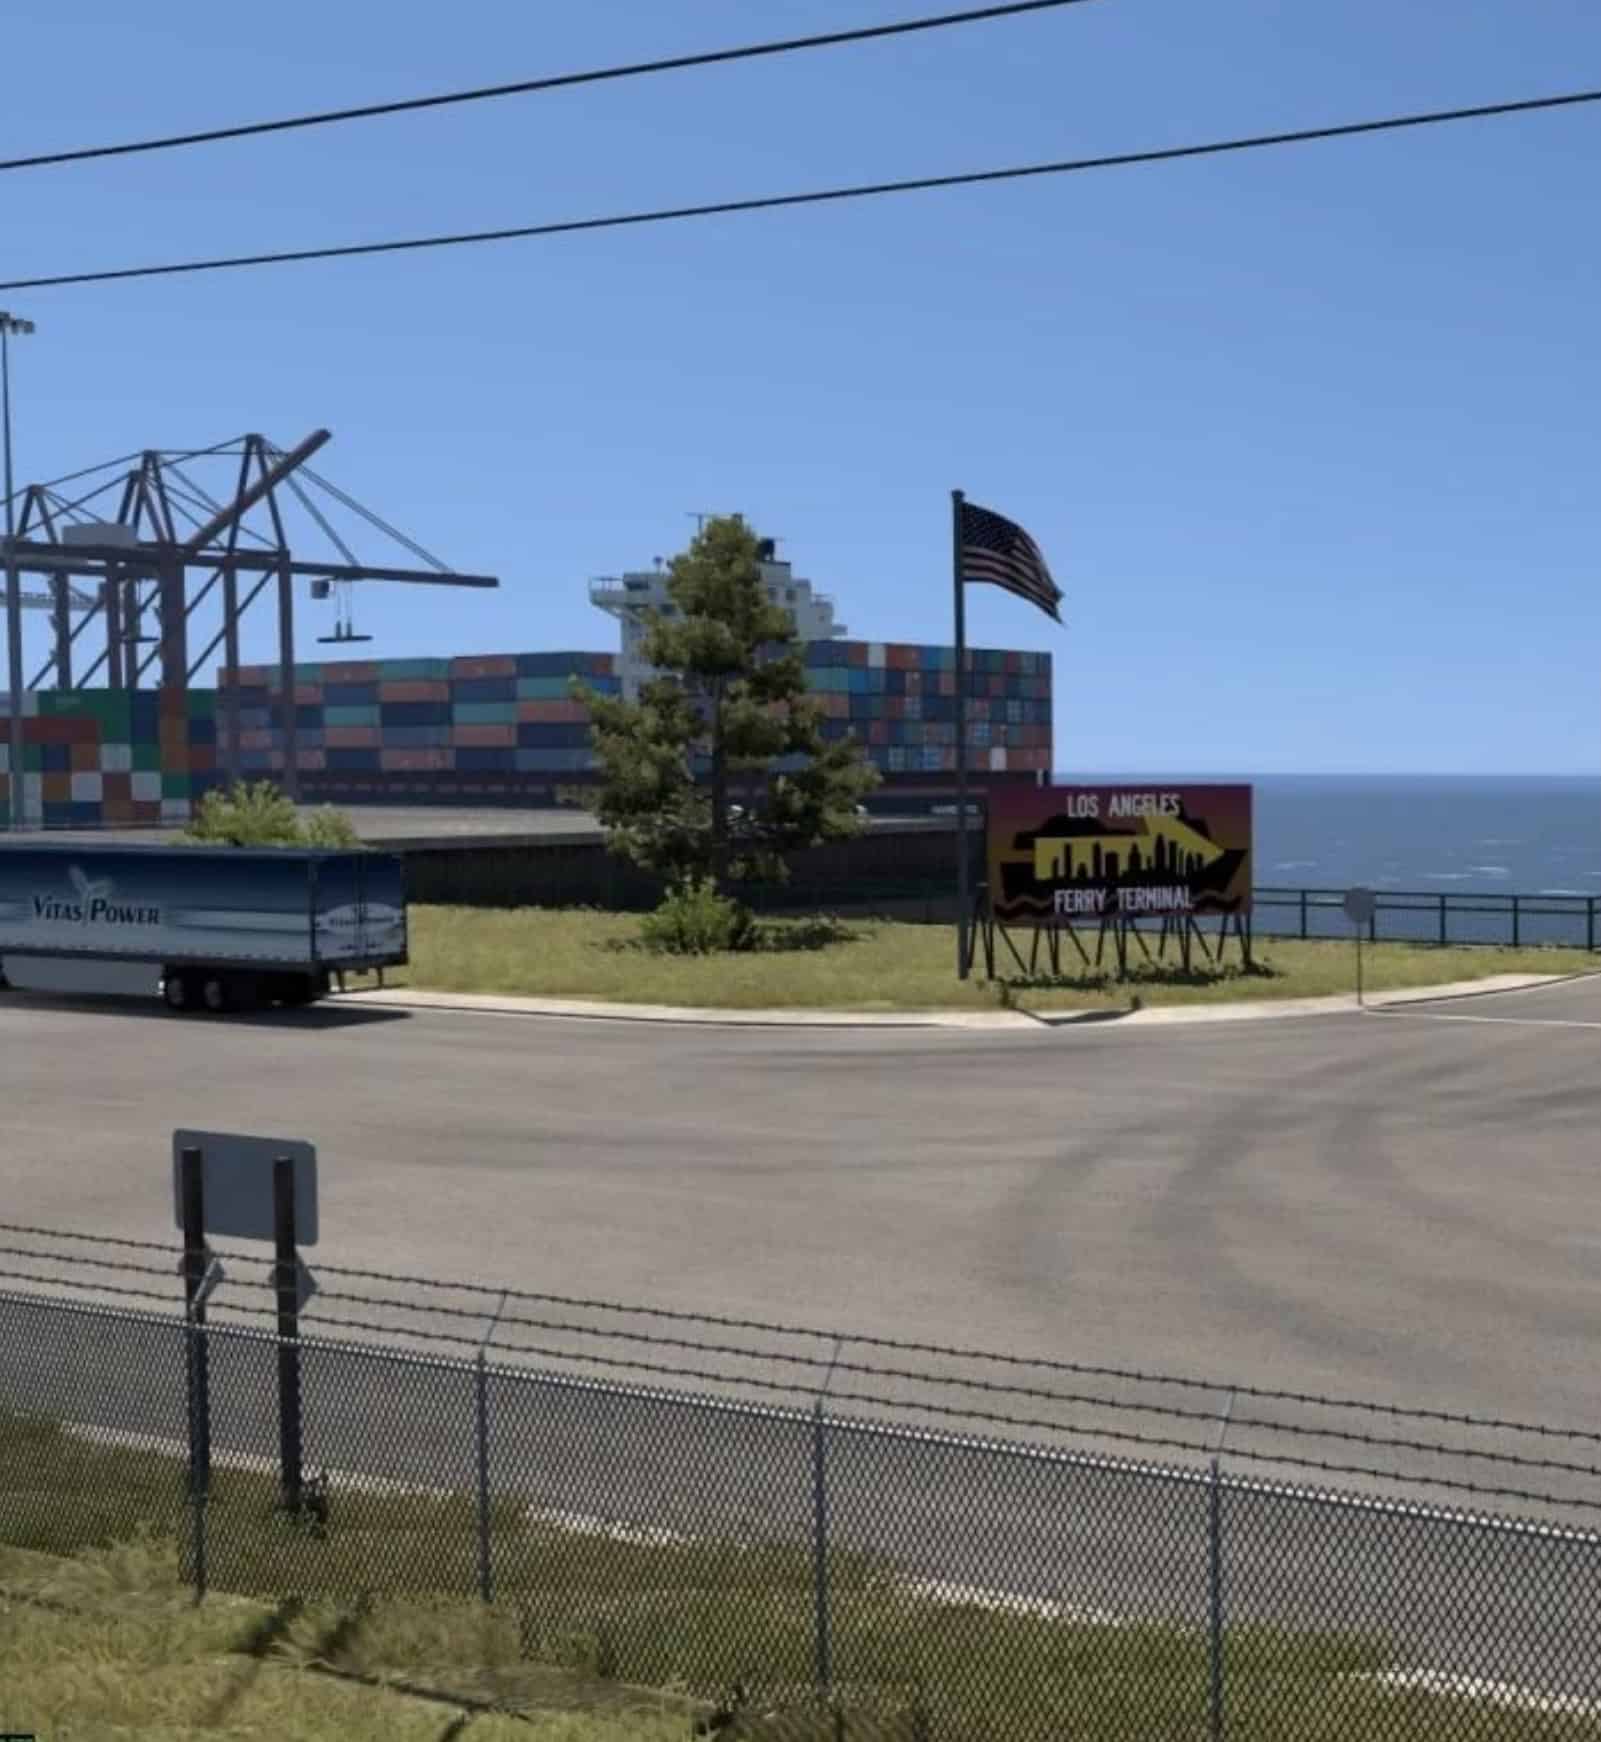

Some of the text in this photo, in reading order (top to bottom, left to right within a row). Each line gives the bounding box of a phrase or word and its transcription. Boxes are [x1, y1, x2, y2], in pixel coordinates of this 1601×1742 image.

[1067, 793, 1181, 817] LOS ANGELES
[91, 898, 160, 925] POWER
[1054, 885, 1194, 913] FERRY TERMINAL
